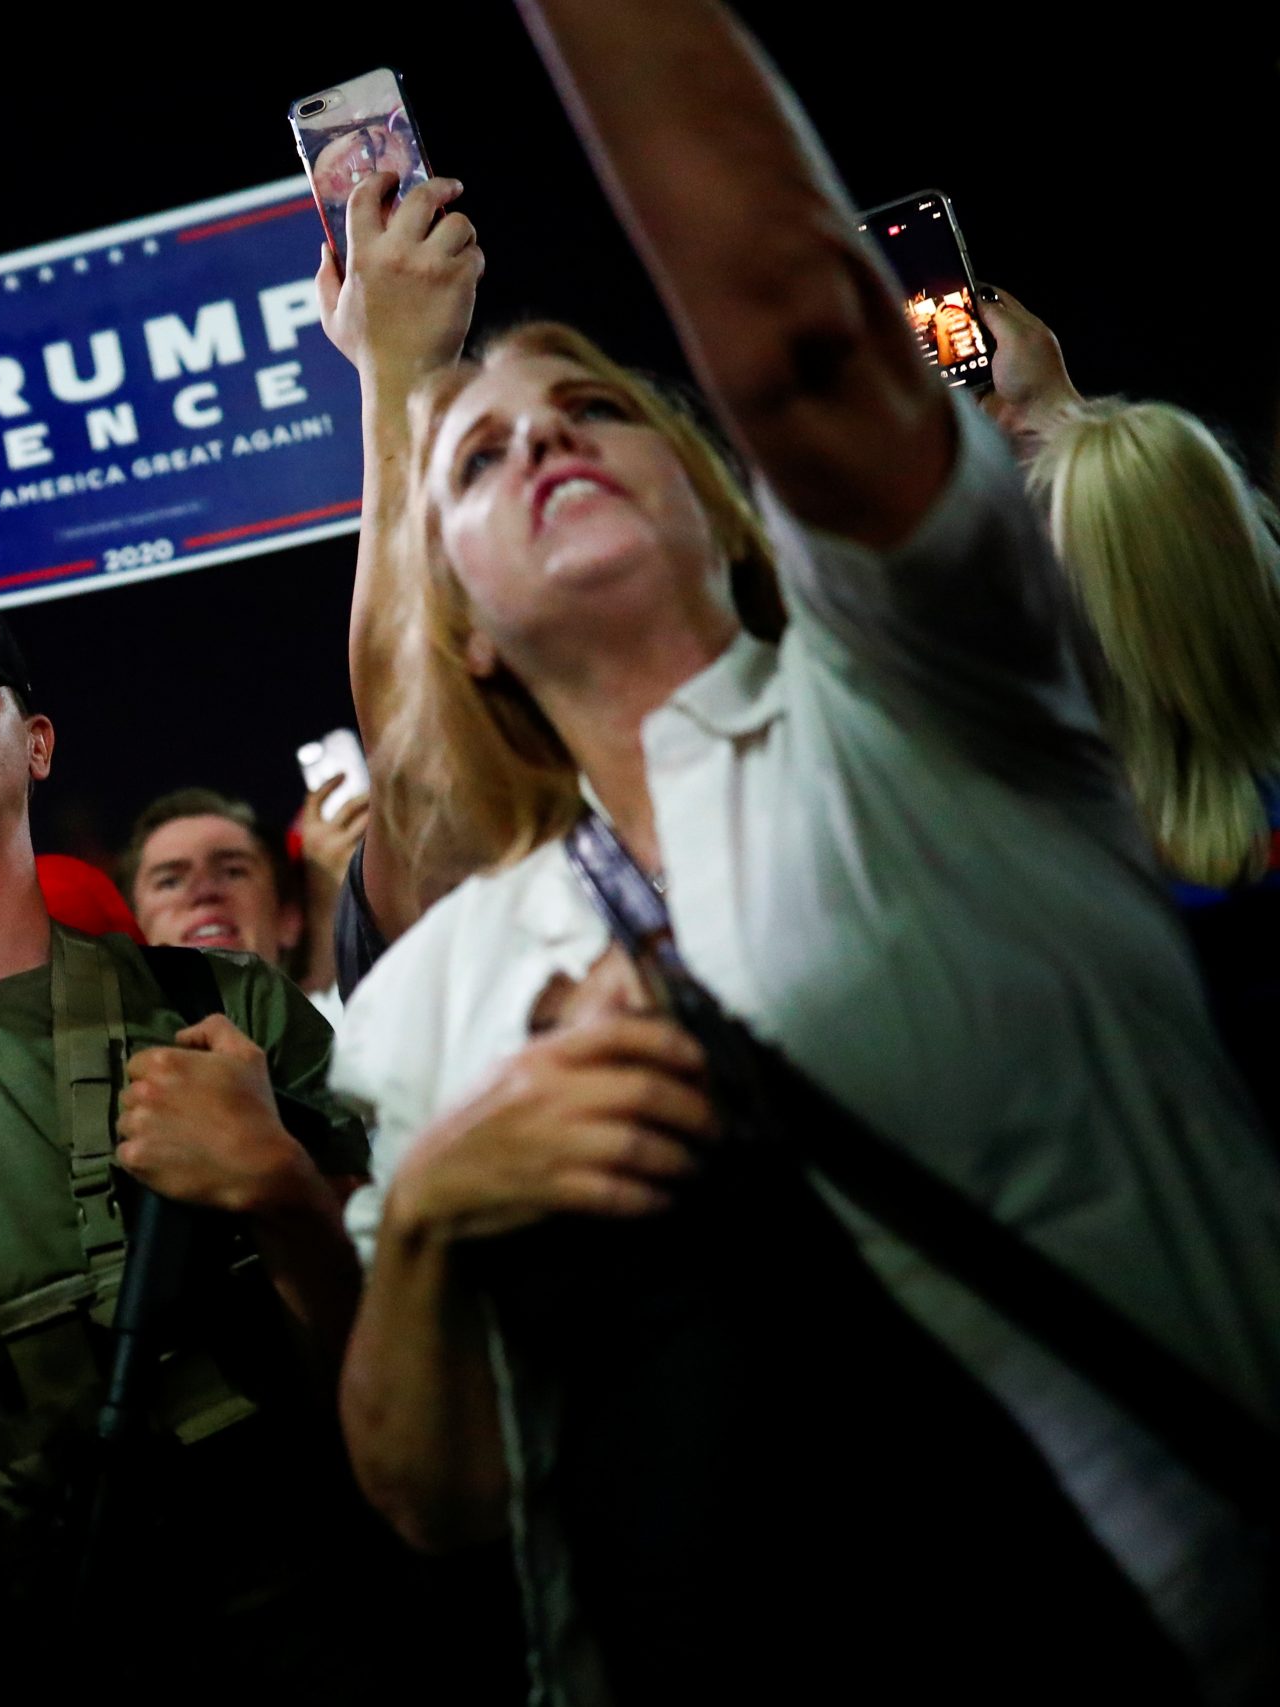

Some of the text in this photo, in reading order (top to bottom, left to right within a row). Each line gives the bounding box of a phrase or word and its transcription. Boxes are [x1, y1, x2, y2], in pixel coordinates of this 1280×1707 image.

[131, 440, 223, 480] GREAT
[232, 413, 334, 457] AGAIN!
[103, 538, 175, 572] 2020
